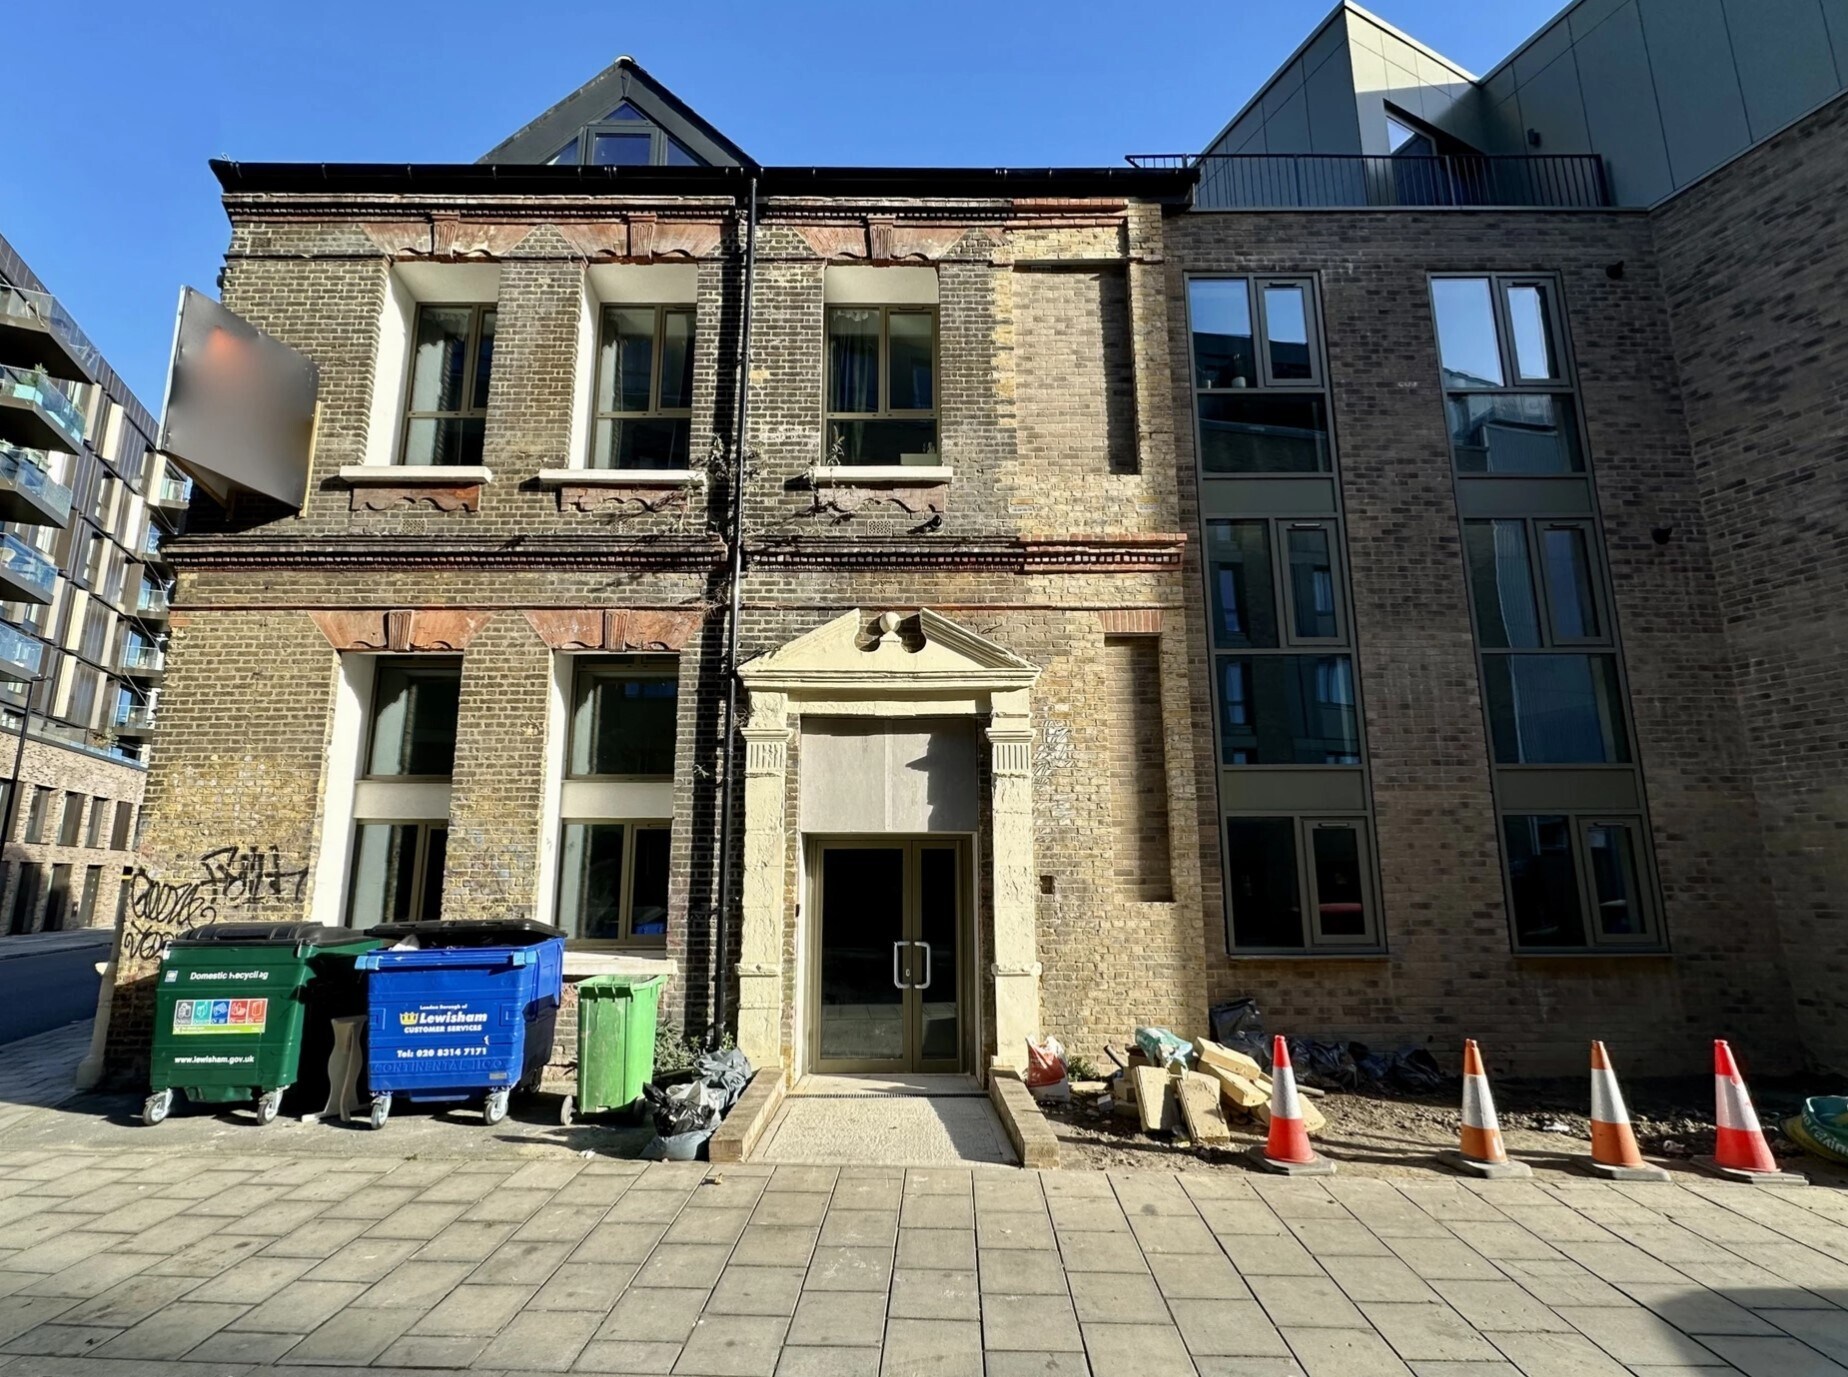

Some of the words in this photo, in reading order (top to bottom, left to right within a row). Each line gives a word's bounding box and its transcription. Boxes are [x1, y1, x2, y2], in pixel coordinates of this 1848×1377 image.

[190, 971, 228, 980] Domestic
[419, 1011, 488, 1024] Lewisham
[404, 1025, 446, 1034] CUSTOMER
[447, 1024, 482, 1032] SERVICES
[397, 1049, 414, 1058] Tel:
[416, 1049, 435, 1057] 020
[436, 1048, 461, 1057] 8314
[463, 1047, 487, 1056] 7171
[174, 1055, 255, 1065] www.lewisham.gov.uk
[375, 1061, 466, 1073] CONTINENTAL
